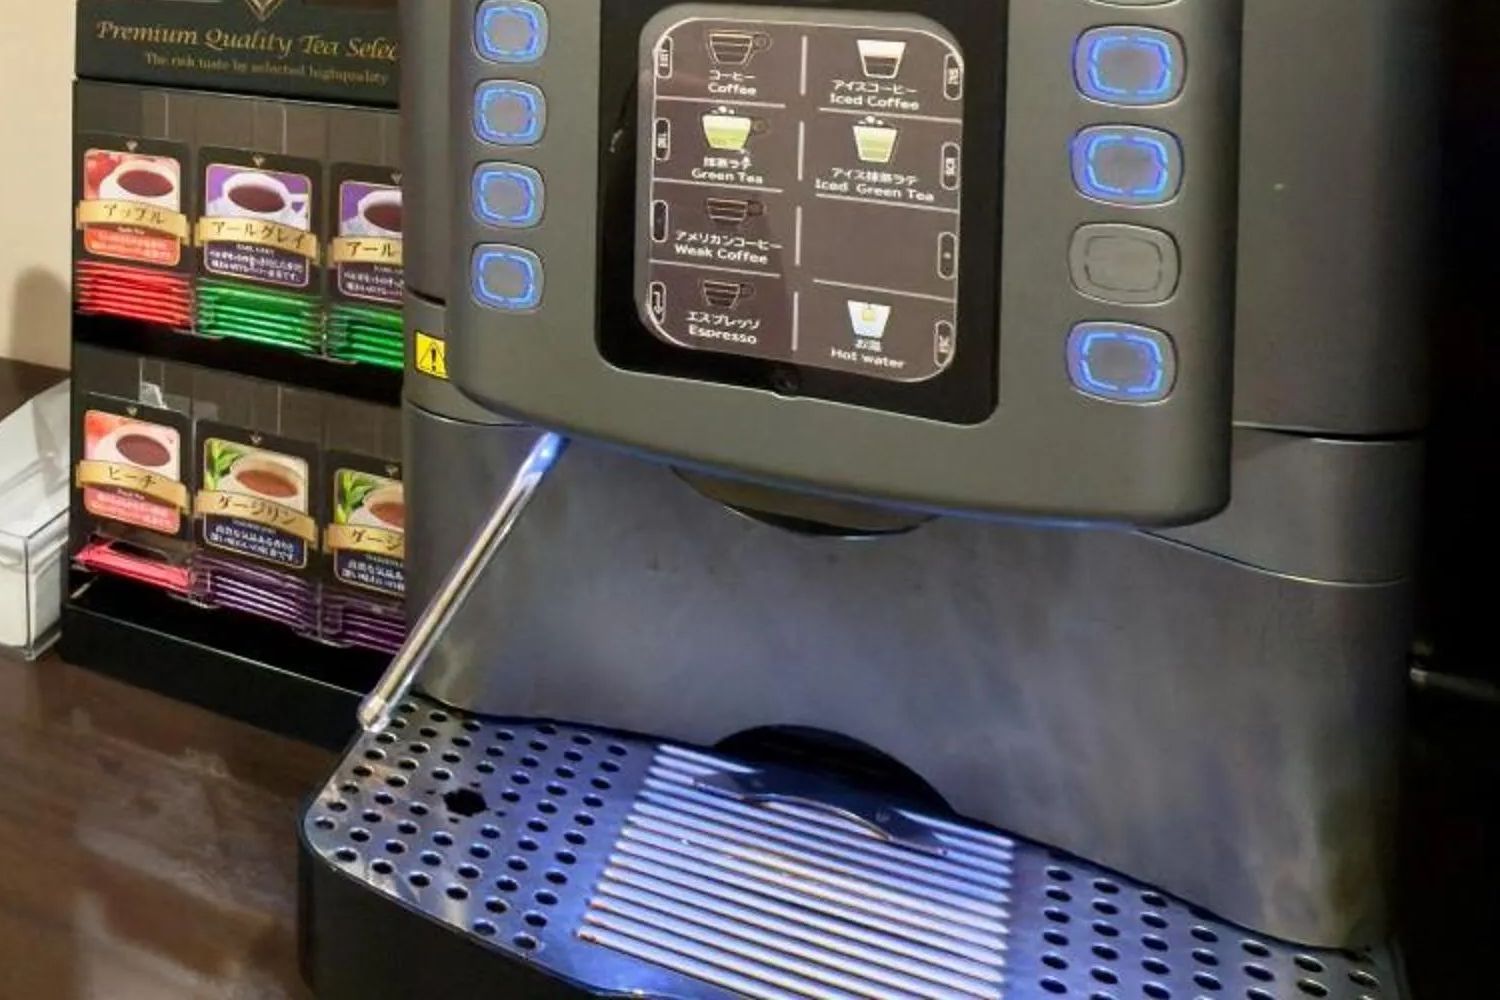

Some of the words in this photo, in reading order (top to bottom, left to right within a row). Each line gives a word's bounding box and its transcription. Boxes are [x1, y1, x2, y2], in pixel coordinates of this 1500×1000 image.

[96, 20, 200, 45] Premium
[203, 27, 293, 59] Quality
[298, 34, 340, 57] Tea
[708, 69, 756, 82] コーヒー
[707, 82, 758, 96] Coffee
[830, 79, 918, 96] アイスコーヒー
[830, 93, 863, 106] Iced
[867, 95, 920, 112] Coffee
[691, 167, 735, 181] Green
[737, 171, 764, 185] Tea
[814, 178, 849, 192] Iced
[855, 183, 903, 199] Green
[905, 188, 935, 202] Tea
[211, 221, 306, 250] アールグレイ
[675, 230, 784, 251] アメリカンコーヒー
[673, 243, 714, 259] Weak
[716, 248, 769, 265] Coffee
[688, 324, 758, 345] Espresso
[831, 346, 858, 362] Hot
[861, 352, 905, 369] water
